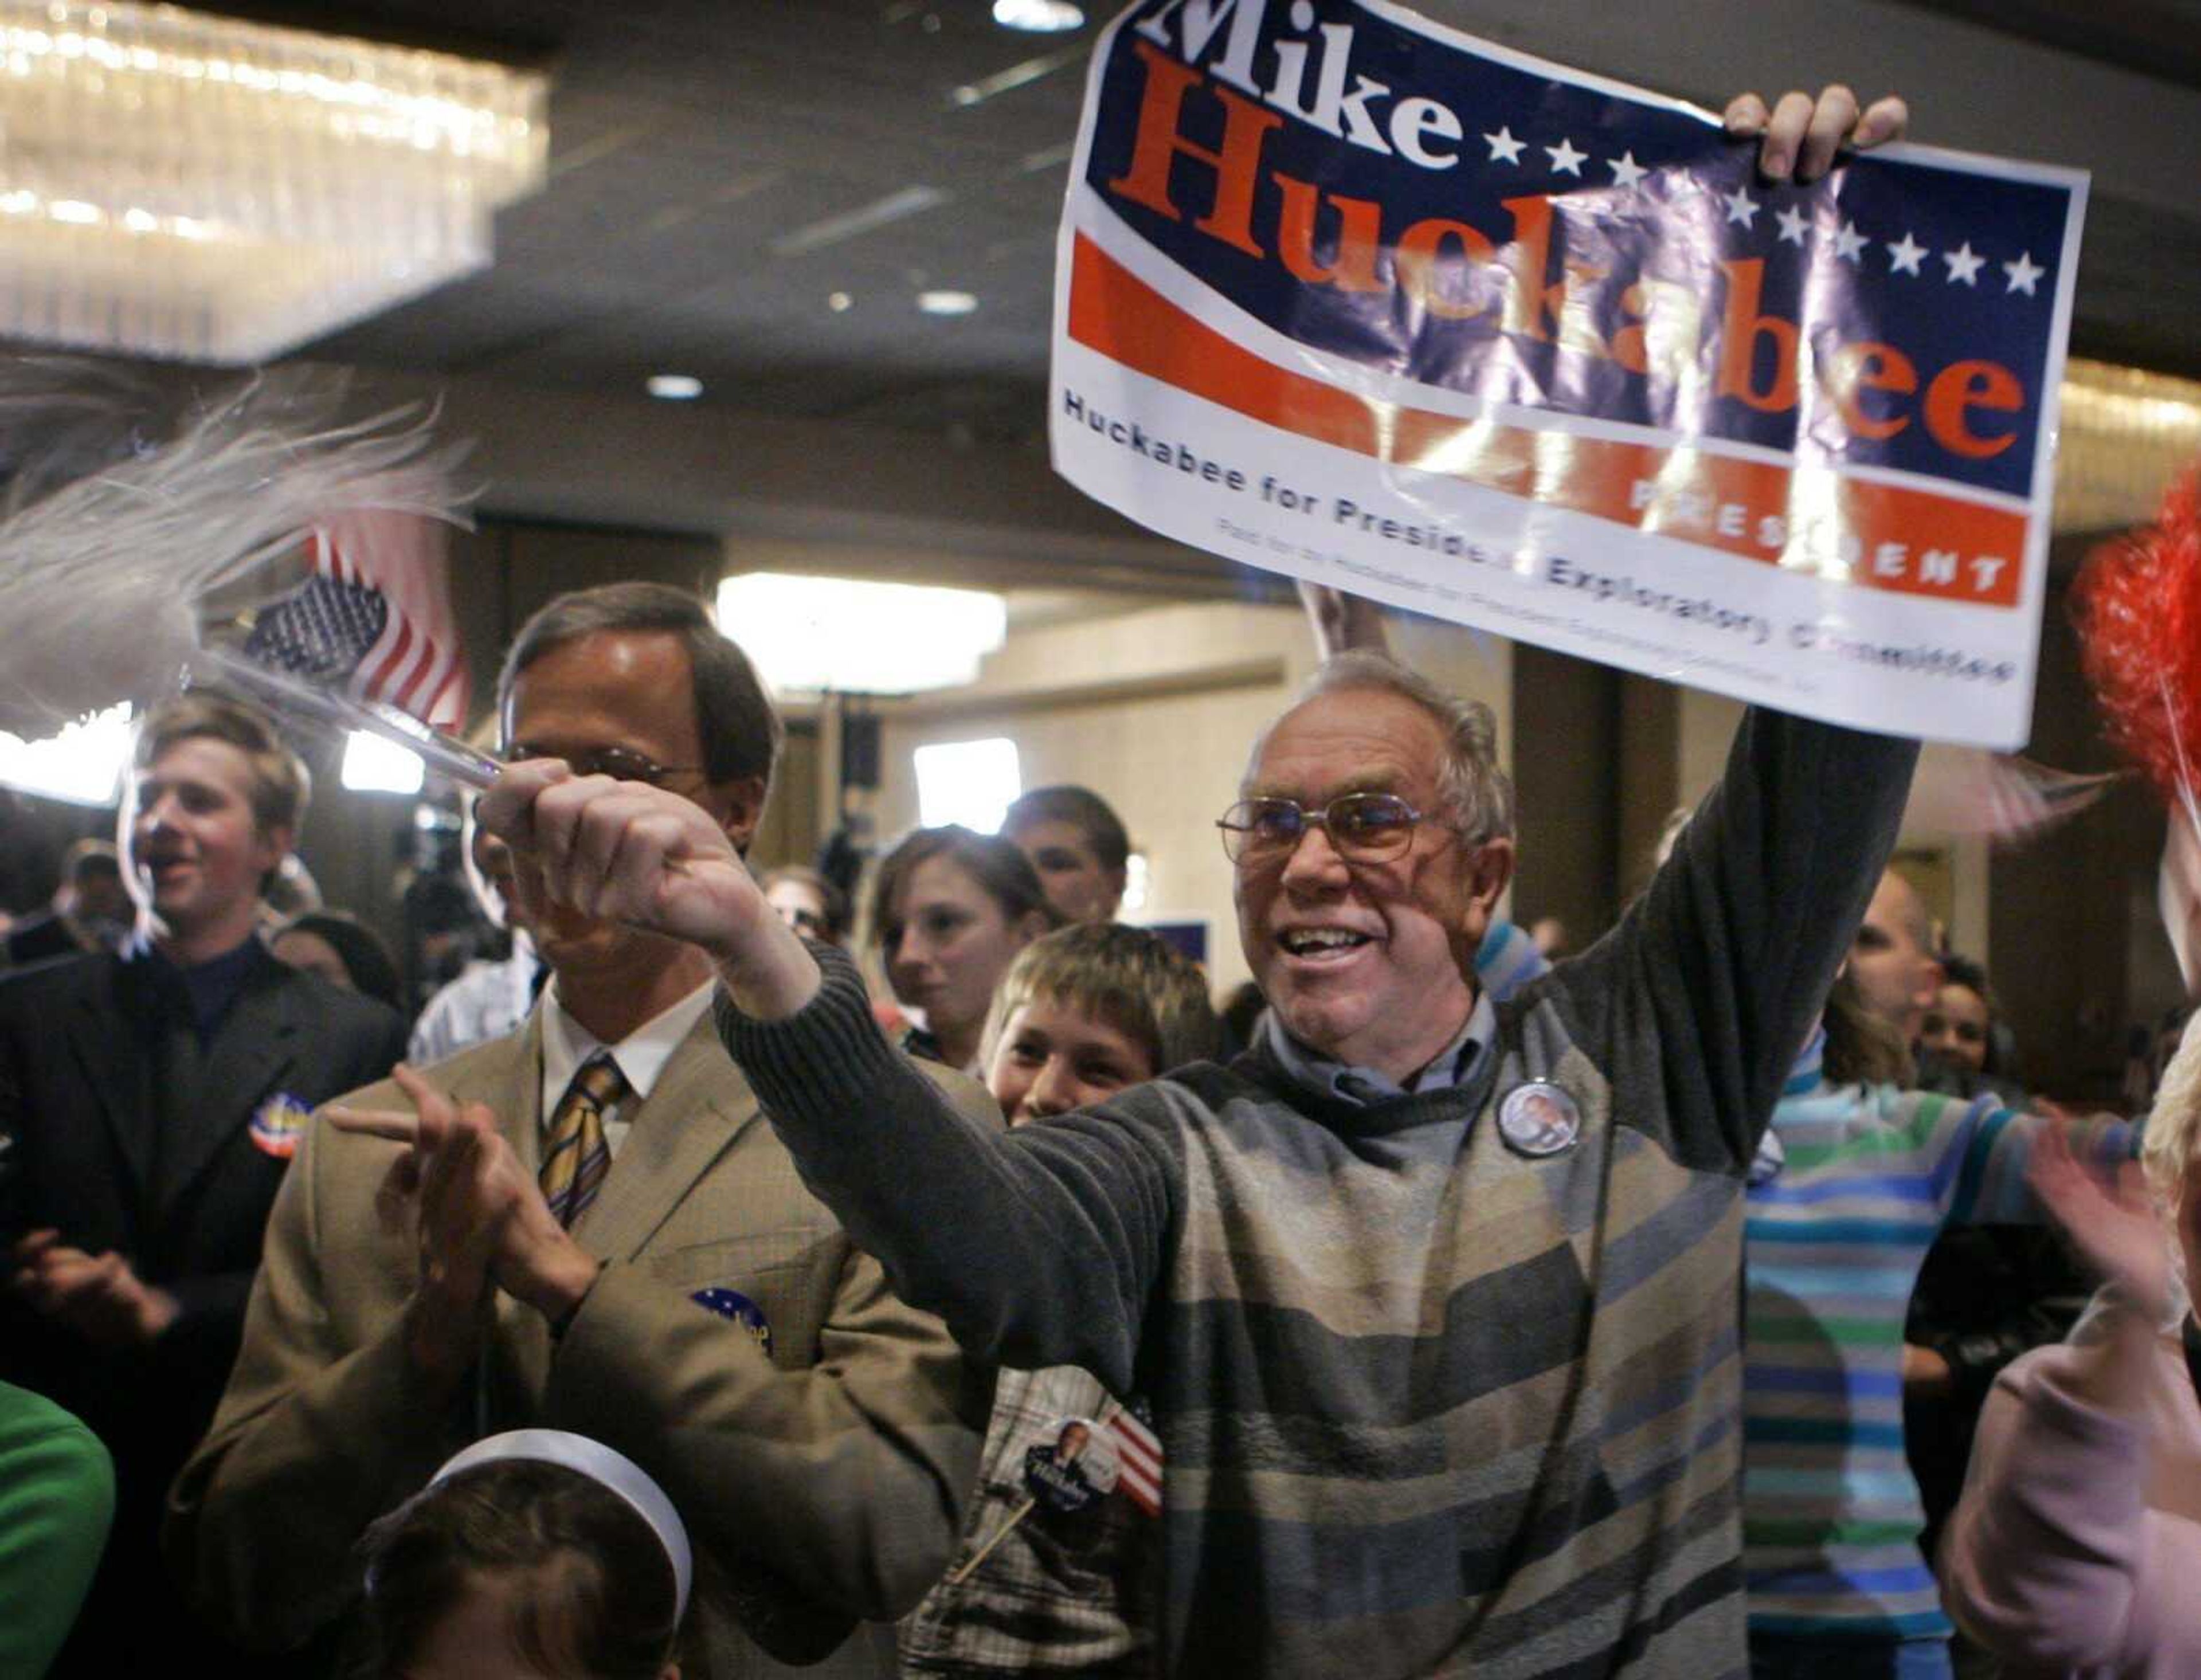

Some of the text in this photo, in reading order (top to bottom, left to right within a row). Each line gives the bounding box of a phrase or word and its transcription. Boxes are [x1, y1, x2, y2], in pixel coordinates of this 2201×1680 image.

[1134, 0, 1463, 170] Mike
[1064, 388, 1246, 491] Huckabee
[1261, 476, 1319, 514] for
[1546, 557, 1771, 645] Exploratory
